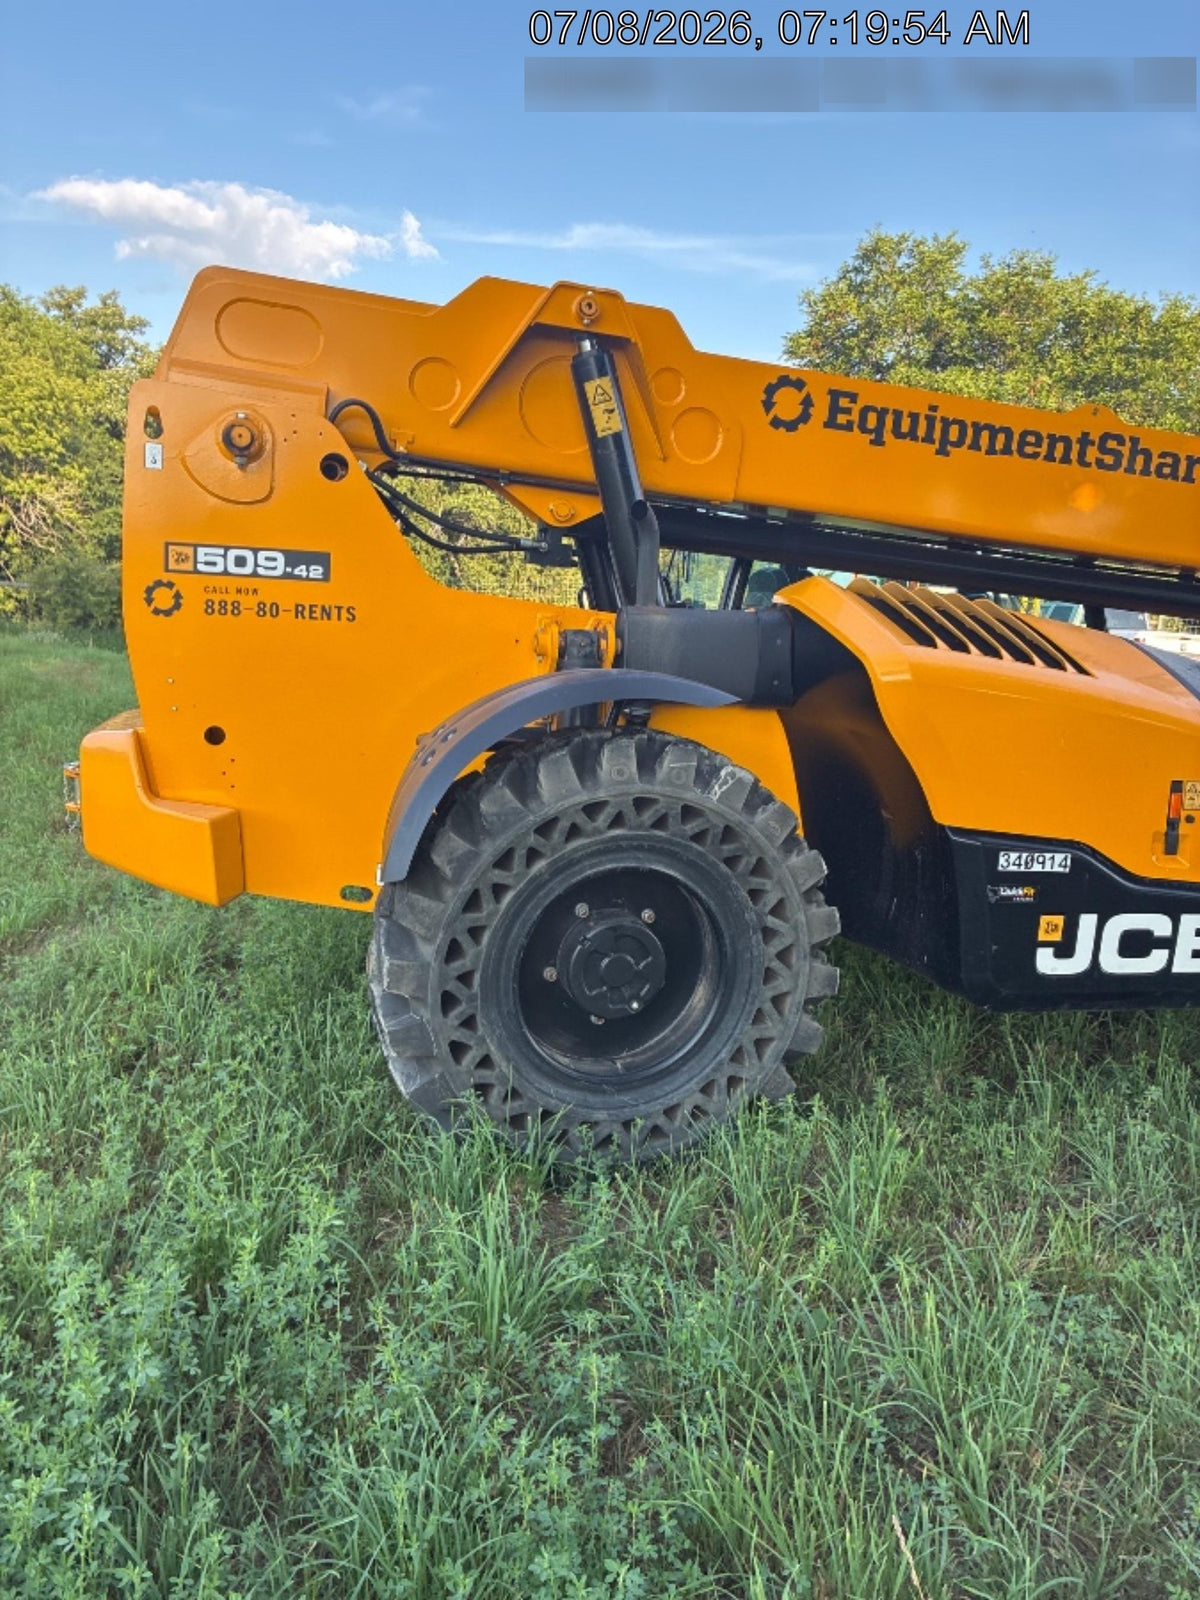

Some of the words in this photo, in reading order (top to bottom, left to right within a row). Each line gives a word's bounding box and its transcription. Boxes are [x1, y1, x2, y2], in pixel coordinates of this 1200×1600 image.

[823, 388, 1200, 484] EquipmentShar
[203, 585, 230, 595] CALL
[235, 586, 259, 596] NOW
[204, 598, 357, 623] 888-80-RENTS
[1000, 852, 1069, 871] 340914
